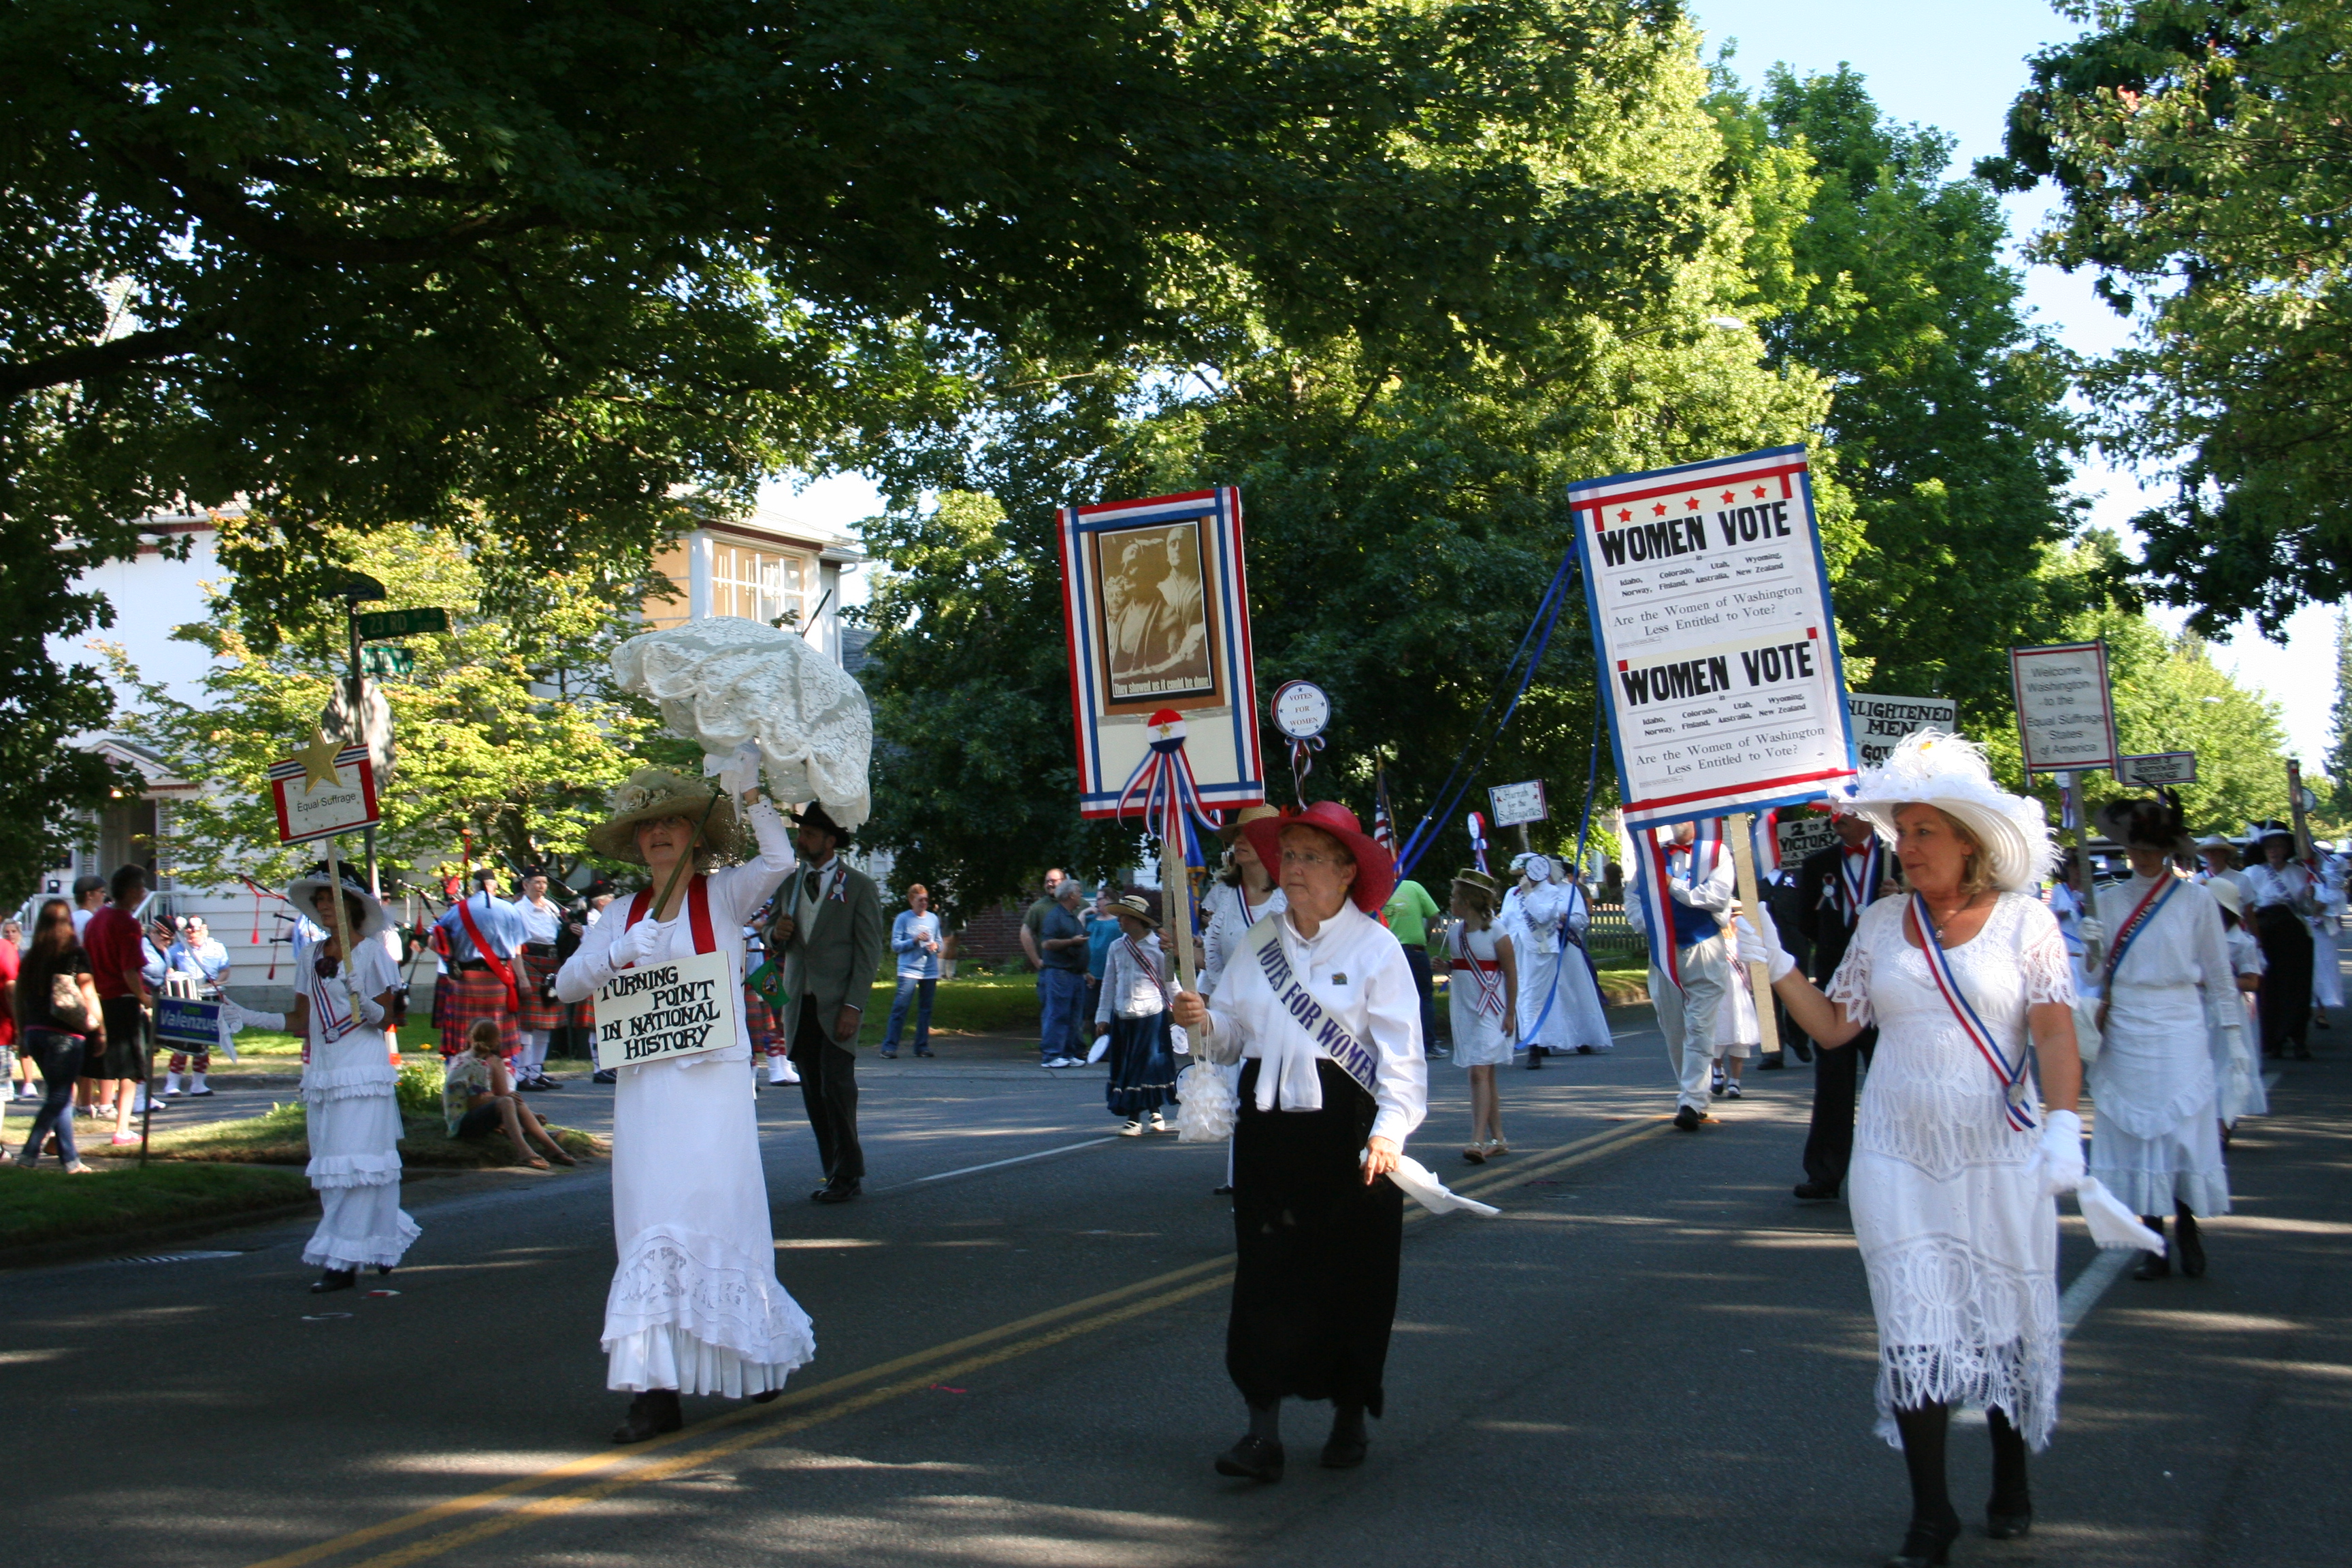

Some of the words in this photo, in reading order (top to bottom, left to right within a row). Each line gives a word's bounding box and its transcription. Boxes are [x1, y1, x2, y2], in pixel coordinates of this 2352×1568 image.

[1596, 514, 1708, 568] WOMEN
[1716, 498, 1792, 547] VOTE
[1619, 577, 1644, 587] Idaho,
[1659, 568, 1695, 579] Colorado,
[1710, 561, 1731, 570] Utah,
[1744, 553, 1782, 564] Wyoming,
[1621, 587, 1653, 598] Norway,
[1659, 579, 1688, 591] Finland,
[1695, 572, 1730, 584] Australia,
[1754, 562, 1784, 574] Zealand
[1614, 616, 1634, 627] Are
[1639, 610, 1659, 622] the
[1663, 602, 1710, 617] Women
[1715, 595, 1728, 608] of
[1732, 587, 1803, 604] Washington
[369, 615, 385, 634] 23
[389, 614, 408, 632] RD
[1644, 625, 1669, 636] Less
[1675, 612, 1720, 630] Entitled
[1726, 612, 1739, 621] to
[1742, 603, 1776, 618] Vote?
[1619, 655, 1731, 707] WOMEN
[1740, 638, 1816, 687] VOTE
[2031, 666, 2081, 677] Welcome
[1289, 692, 1313, 701] VOTES
[2026, 681, 2090, 692] Washington
[1295, 705, 1310, 713] FOR
[1642, 717, 1666, 725] Idaho,
[1682, 707, 1718, 719] Colorado,
[1733, 701, 1753, 710] Utah,
[1767, 693, 1805, 704] Wyoming,
[1847, 699, 1953, 721] NLIGHTENED
[2044, 697, 2055, 706] to
[2057, 696, 2074, 705] the
[1290, 717, 1318, 726] WOMEN
[1644, 726, 1676, 736] Norway,
[1681, 719, 1711, 730] Finland,
[1718, 713, 1753, 723] Australia,
[1758, 709, 1775, 717] New
[1777, 703, 1807, 714] Zealand
[1864, 717, 1921, 737] MEN
[2026, 716, 2055, 728] Equal
[2058, 714, 2104, 725] Suffrage
[1636, 755, 1656, 766] Are
[1662, 749, 1681, 761] the
[1686, 742, 1733, 756] Women
[1737, 736, 1750, 748] of
[1754, 728, 1826, 745] Washington
[2048, 730, 2083, 740] States
[1666, 764, 1692, 775] Less
[1697, 753, 1742, 770] Entitled
[1748, 753, 1761, 761] to
[1763, 744, 1799, 758] Vote?
[2040, 745, 2050, 755] of
[2053, 743, 2097, 754] America
[297, 799, 319, 813] Equal
[321, 794, 356, 807] Suffrage
[1791, 822, 1806, 836] 2
[1822, 817, 1834, 832] 1
[1778, 832, 1838, 852] VICTORY
[597, 965, 679, 1002] TURNING
[651, 979, 715, 1011] POINT
[160, 1008, 218, 1032] Valenzue
[600, 1019, 623, 1042] IN
[627, 1000, 721, 1037] NATIONAL
[1256, 937, 1292, 992] VOTES
[1281, 981, 1322, 1032] FOR
[1316, 1017, 1377, 1090] WOMEN
[623, 1023, 715, 1060] HISTORY
